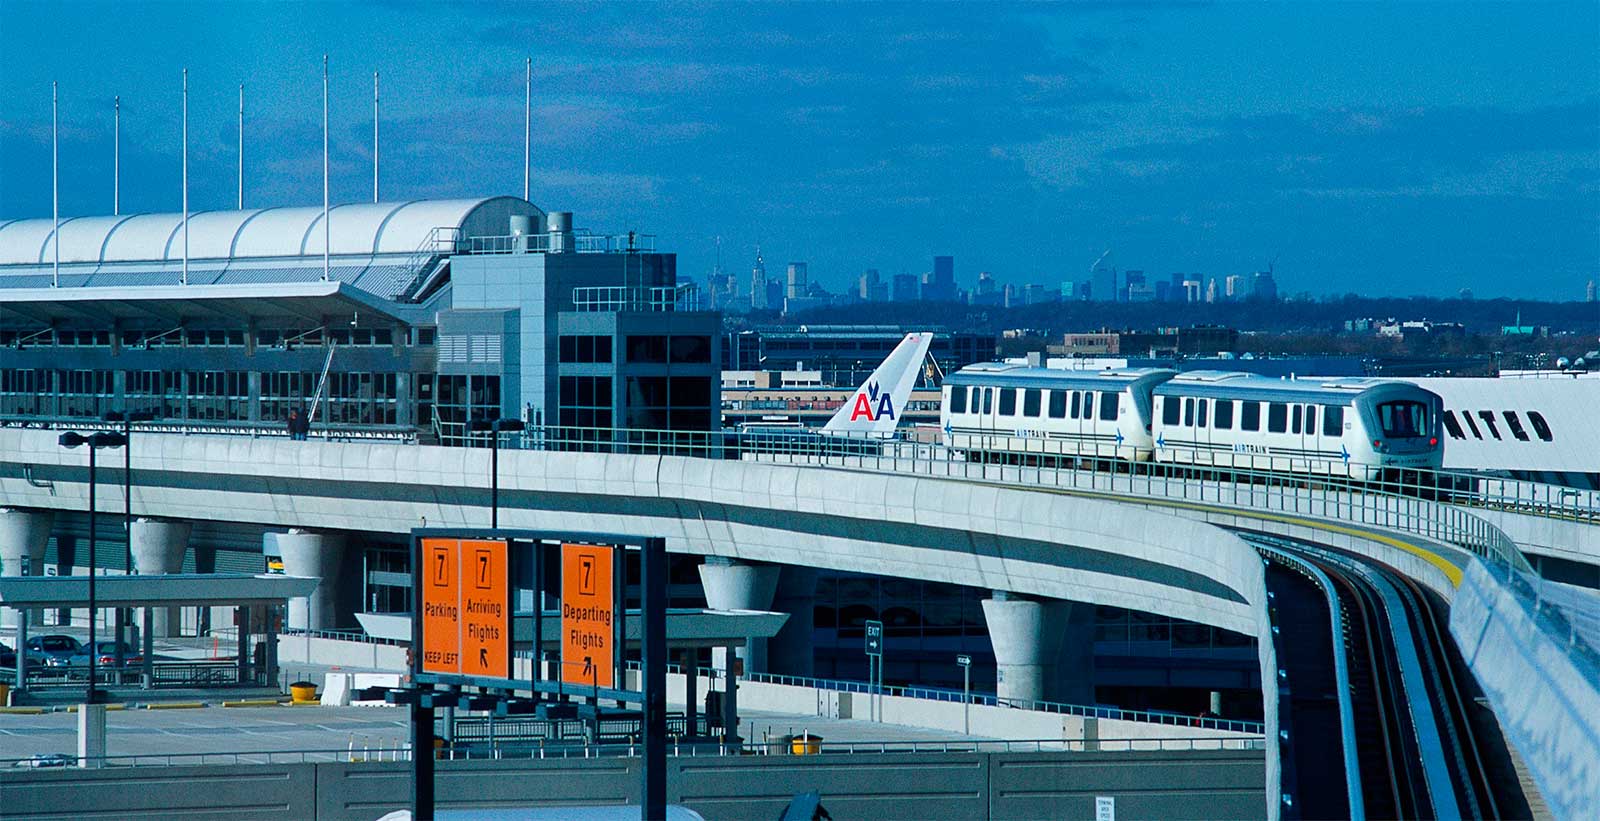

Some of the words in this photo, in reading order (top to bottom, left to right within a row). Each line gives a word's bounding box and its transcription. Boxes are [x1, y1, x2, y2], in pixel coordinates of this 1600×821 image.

[850, 393, 895, 421] AA
[1016, 429, 1047, 438] AIRTRAIN
[1442, 409, 1553, 441] NITED
[1234, 444, 1267, 454] AIRTRAIN
[438, 555, 444, 580] 7
[480, 557, 487, 583] 7
[583, 562, 591, 588] 7
[425, 602, 457, 622] Parking
[466, 599, 501, 618] Arriving
[564, 604, 611, 626] Departing
[468, 623, 499, 643] Flights
[571, 630, 604, 650] Flights
[868, 626, 879, 637] EXIT
[424, 651, 441, 664] KEEP
[443, 653, 458, 665] LEFT
